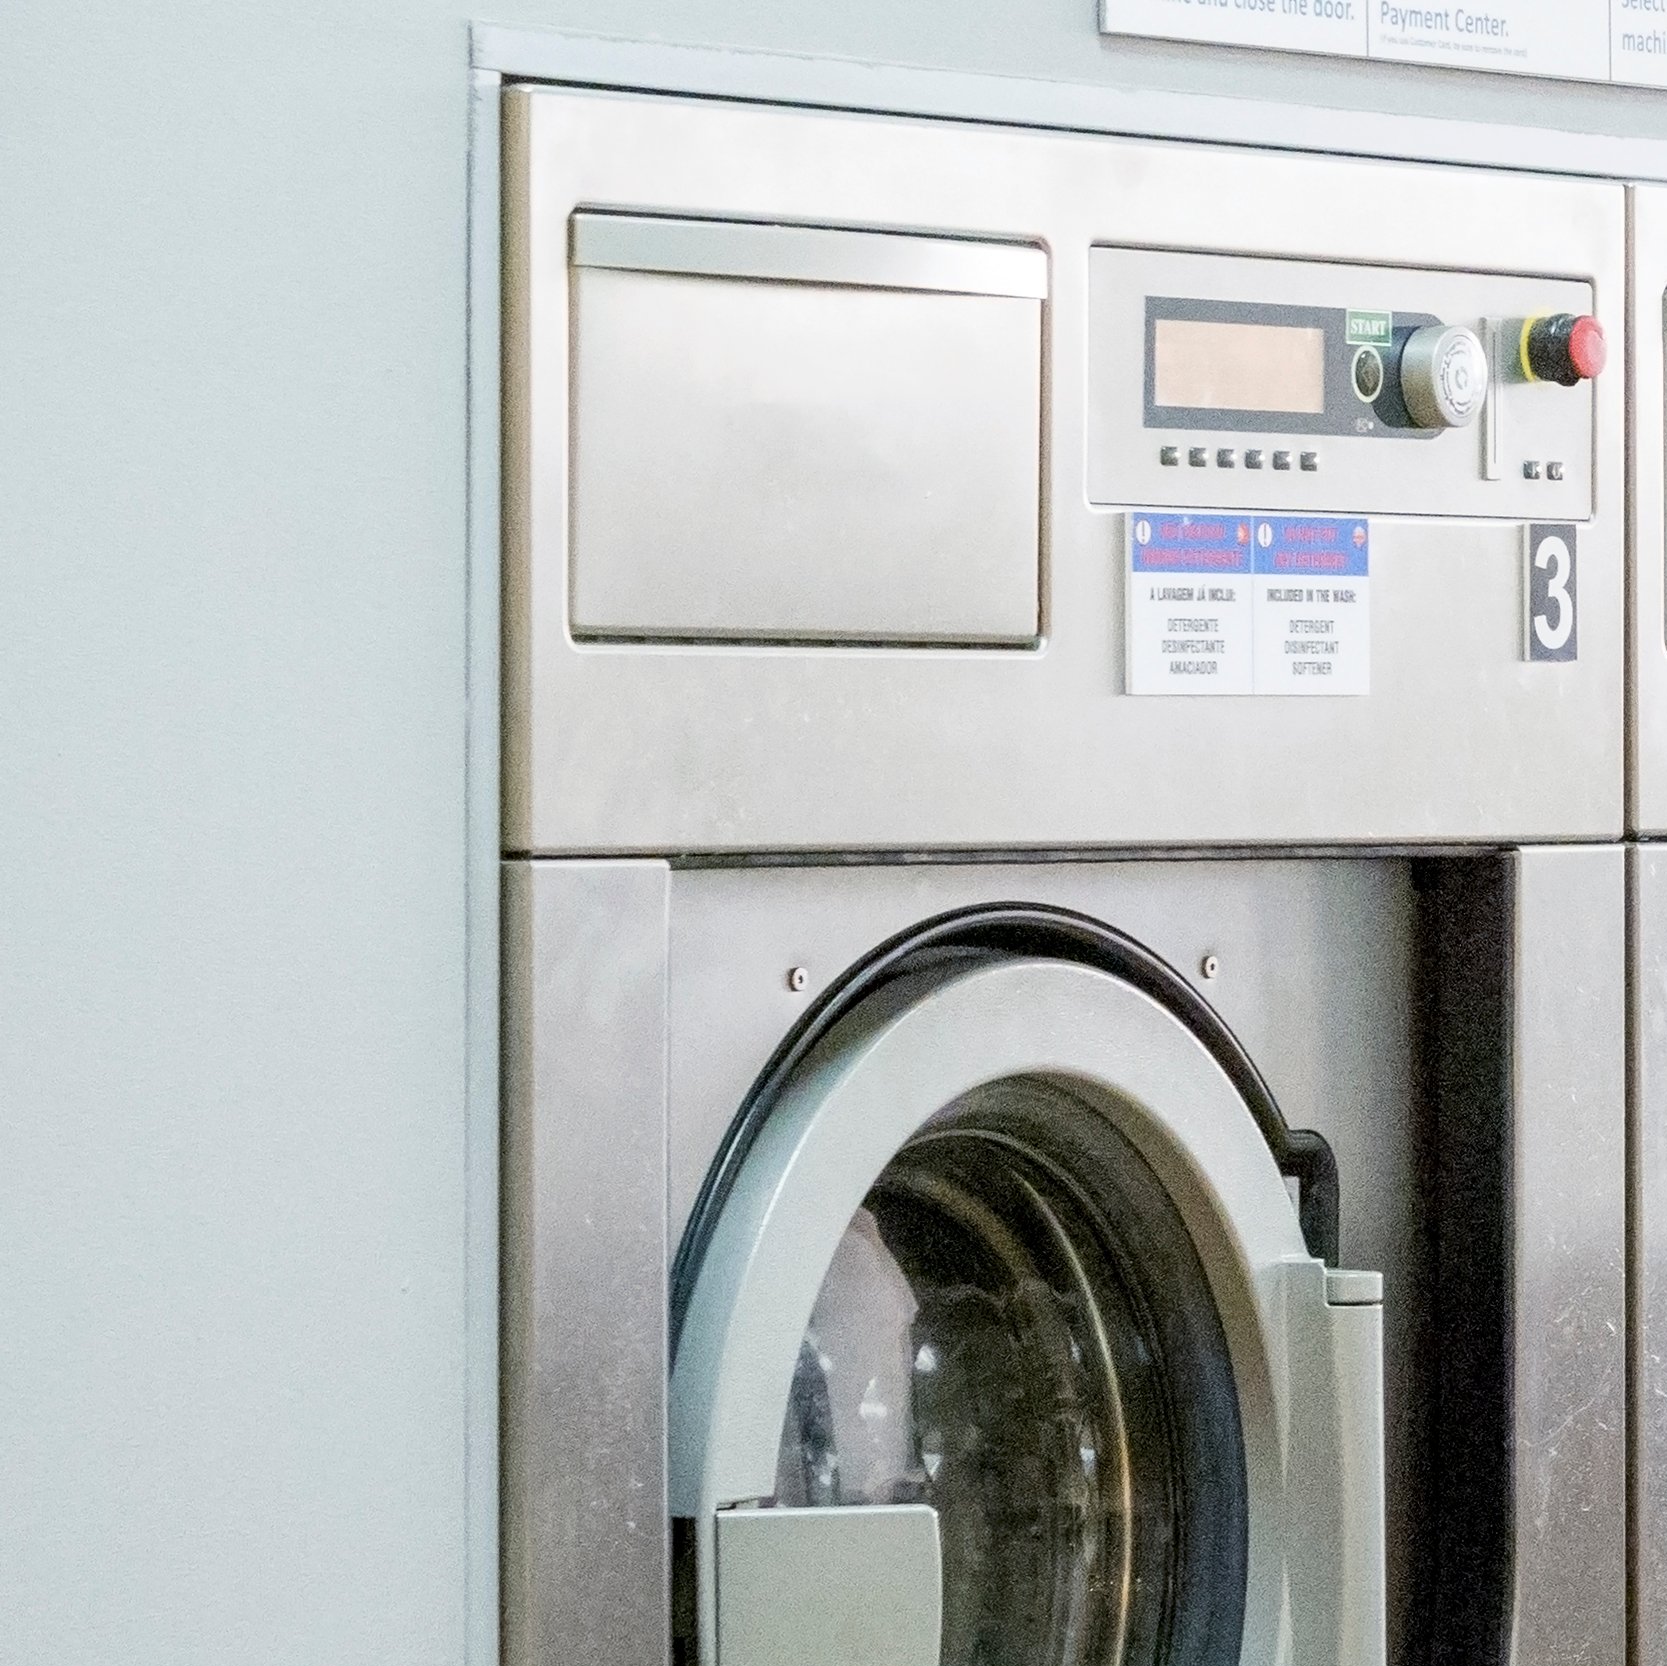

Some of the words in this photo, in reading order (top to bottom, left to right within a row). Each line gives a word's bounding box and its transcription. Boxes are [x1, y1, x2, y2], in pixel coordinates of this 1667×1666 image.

[1314, 0, 1355, 20] door.
[1380, 1, 1450, 32] Payment
[1455, 9, 1509, 37] Center.
[1350, 317, 1386, 336] START
[1150, 587, 1154, 601] A
[1158, 587, 1194, 601] LAVAGEM
[1267, 589, 1303, 602] INCLUDED
[1306, 589, 1314, 602] IN
[1316, 589, 1330, 602] THE
[1533, 536, 1574, 651] 3
[1167, 618, 1219, 633] DETERGENTE
[1289, 619, 1335, 634] DETERGENT
[1161, 640, 1225, 654] DESINFECTANTE
[1284, 640, 1340, 654] DISINFECTANT
[1169, 661, 1218, 675] AMACIADOR
[1292, 661, 1332, 675] SOFTENER
